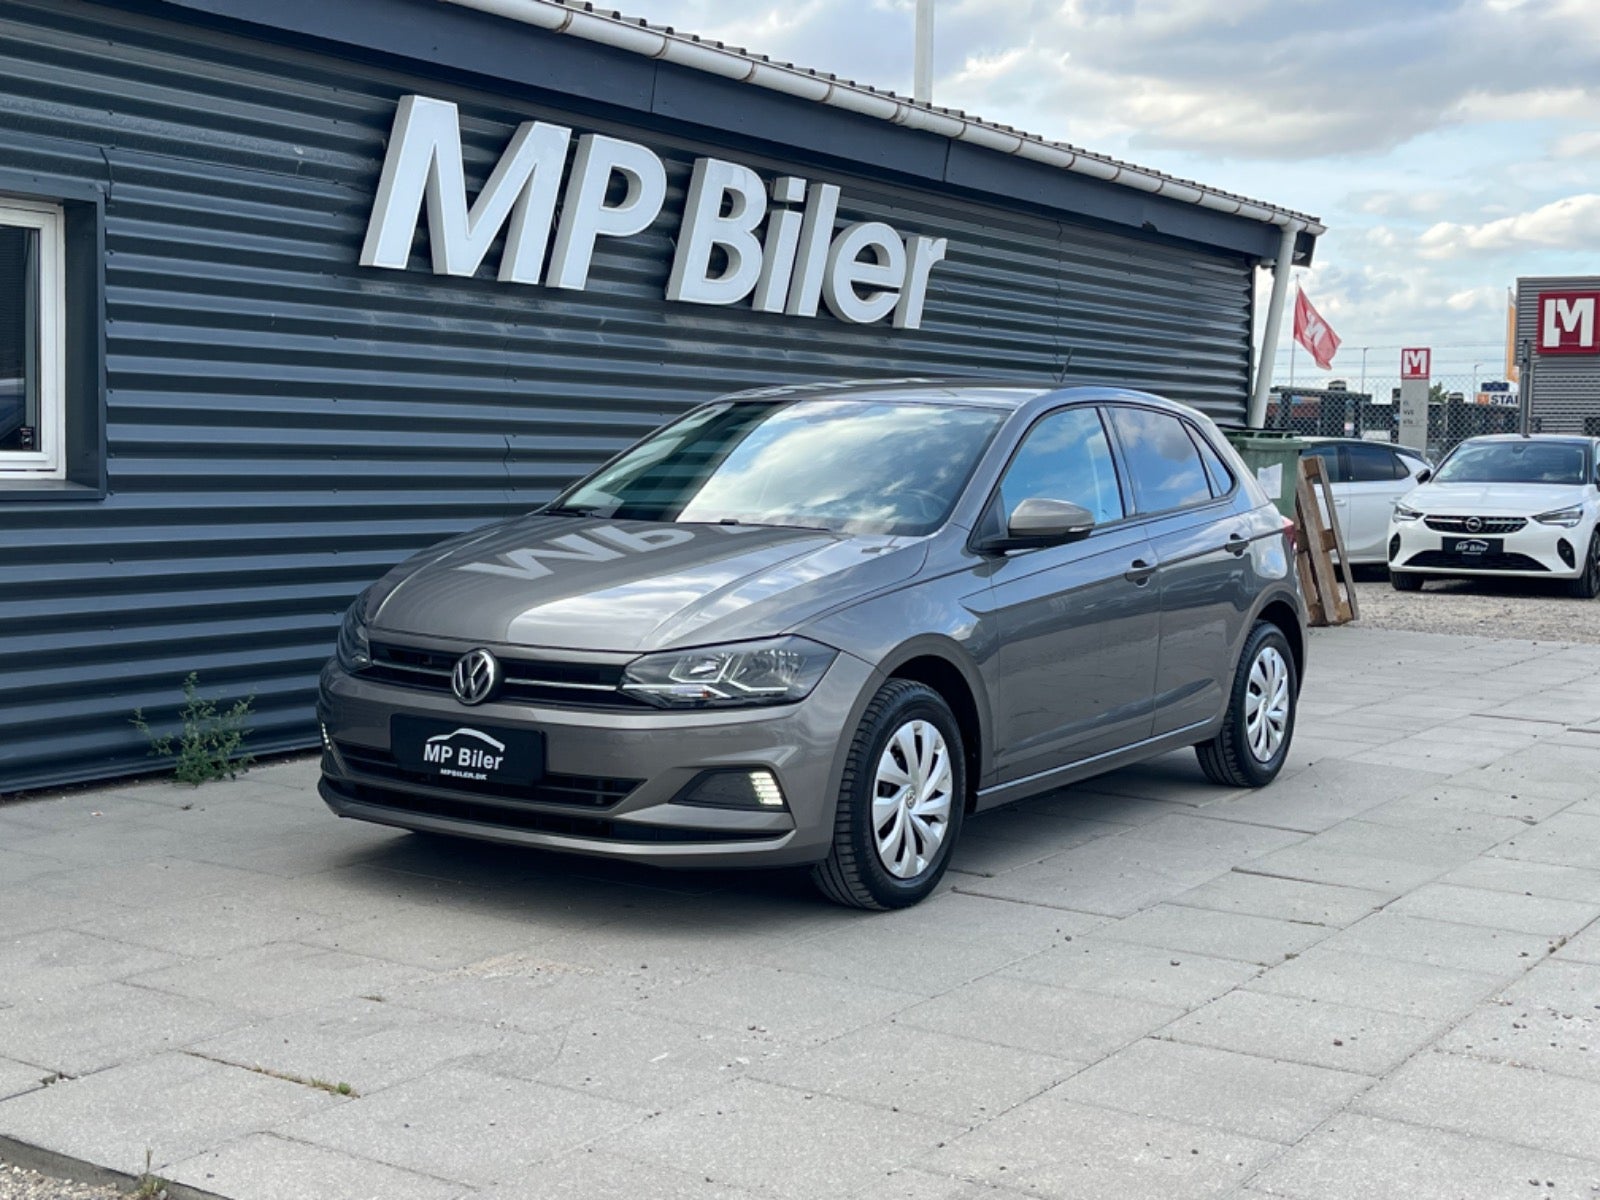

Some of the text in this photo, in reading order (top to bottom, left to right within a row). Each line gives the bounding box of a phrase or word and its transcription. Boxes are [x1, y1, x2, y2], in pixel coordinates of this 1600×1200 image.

[359, 95, 948, 329] MP Biler
[1490, 393, 1519, 406] STA
[423, 743, 504, 770] MP Biler
[440, 767, 488, 781] MPBILER.DK
